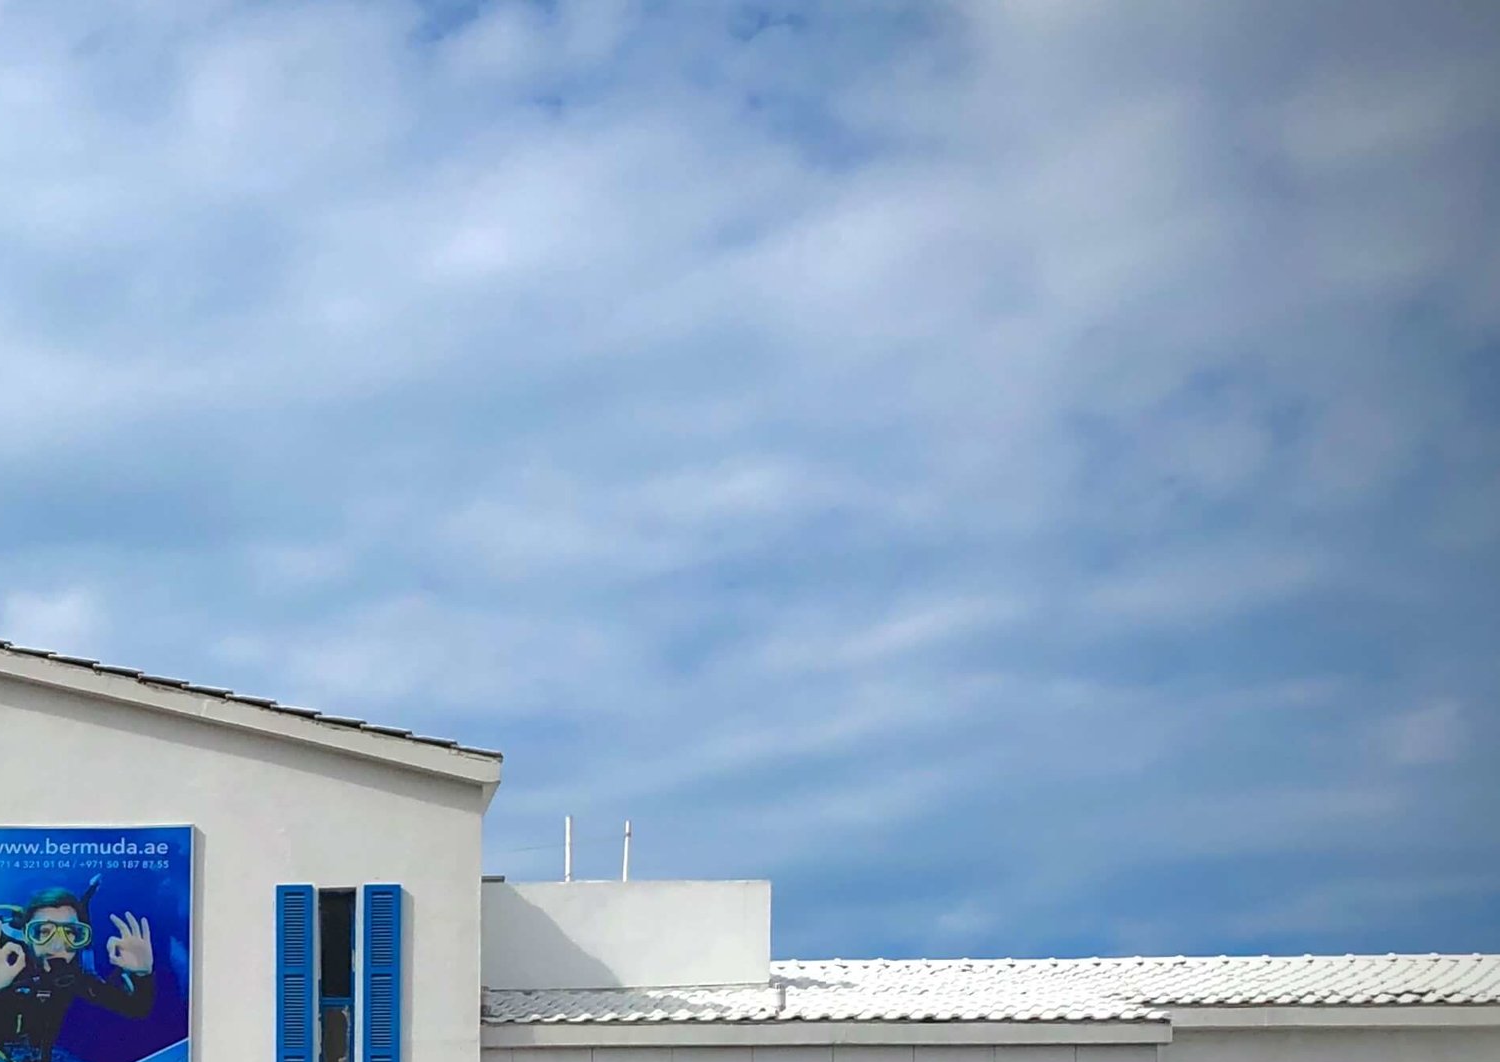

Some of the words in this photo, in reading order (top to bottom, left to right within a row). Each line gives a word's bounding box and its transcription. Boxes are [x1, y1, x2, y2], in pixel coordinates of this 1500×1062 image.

[14, 860, 20, 869] 4
[23, 860, 40, 869] 321
[43, 860, 55, 869] 01
[58, 860, 70, 869] 04
[79, 860, 103, 869] +971
[106, 860, 119, 869] 50
[122, 860, 140, 869] 187
